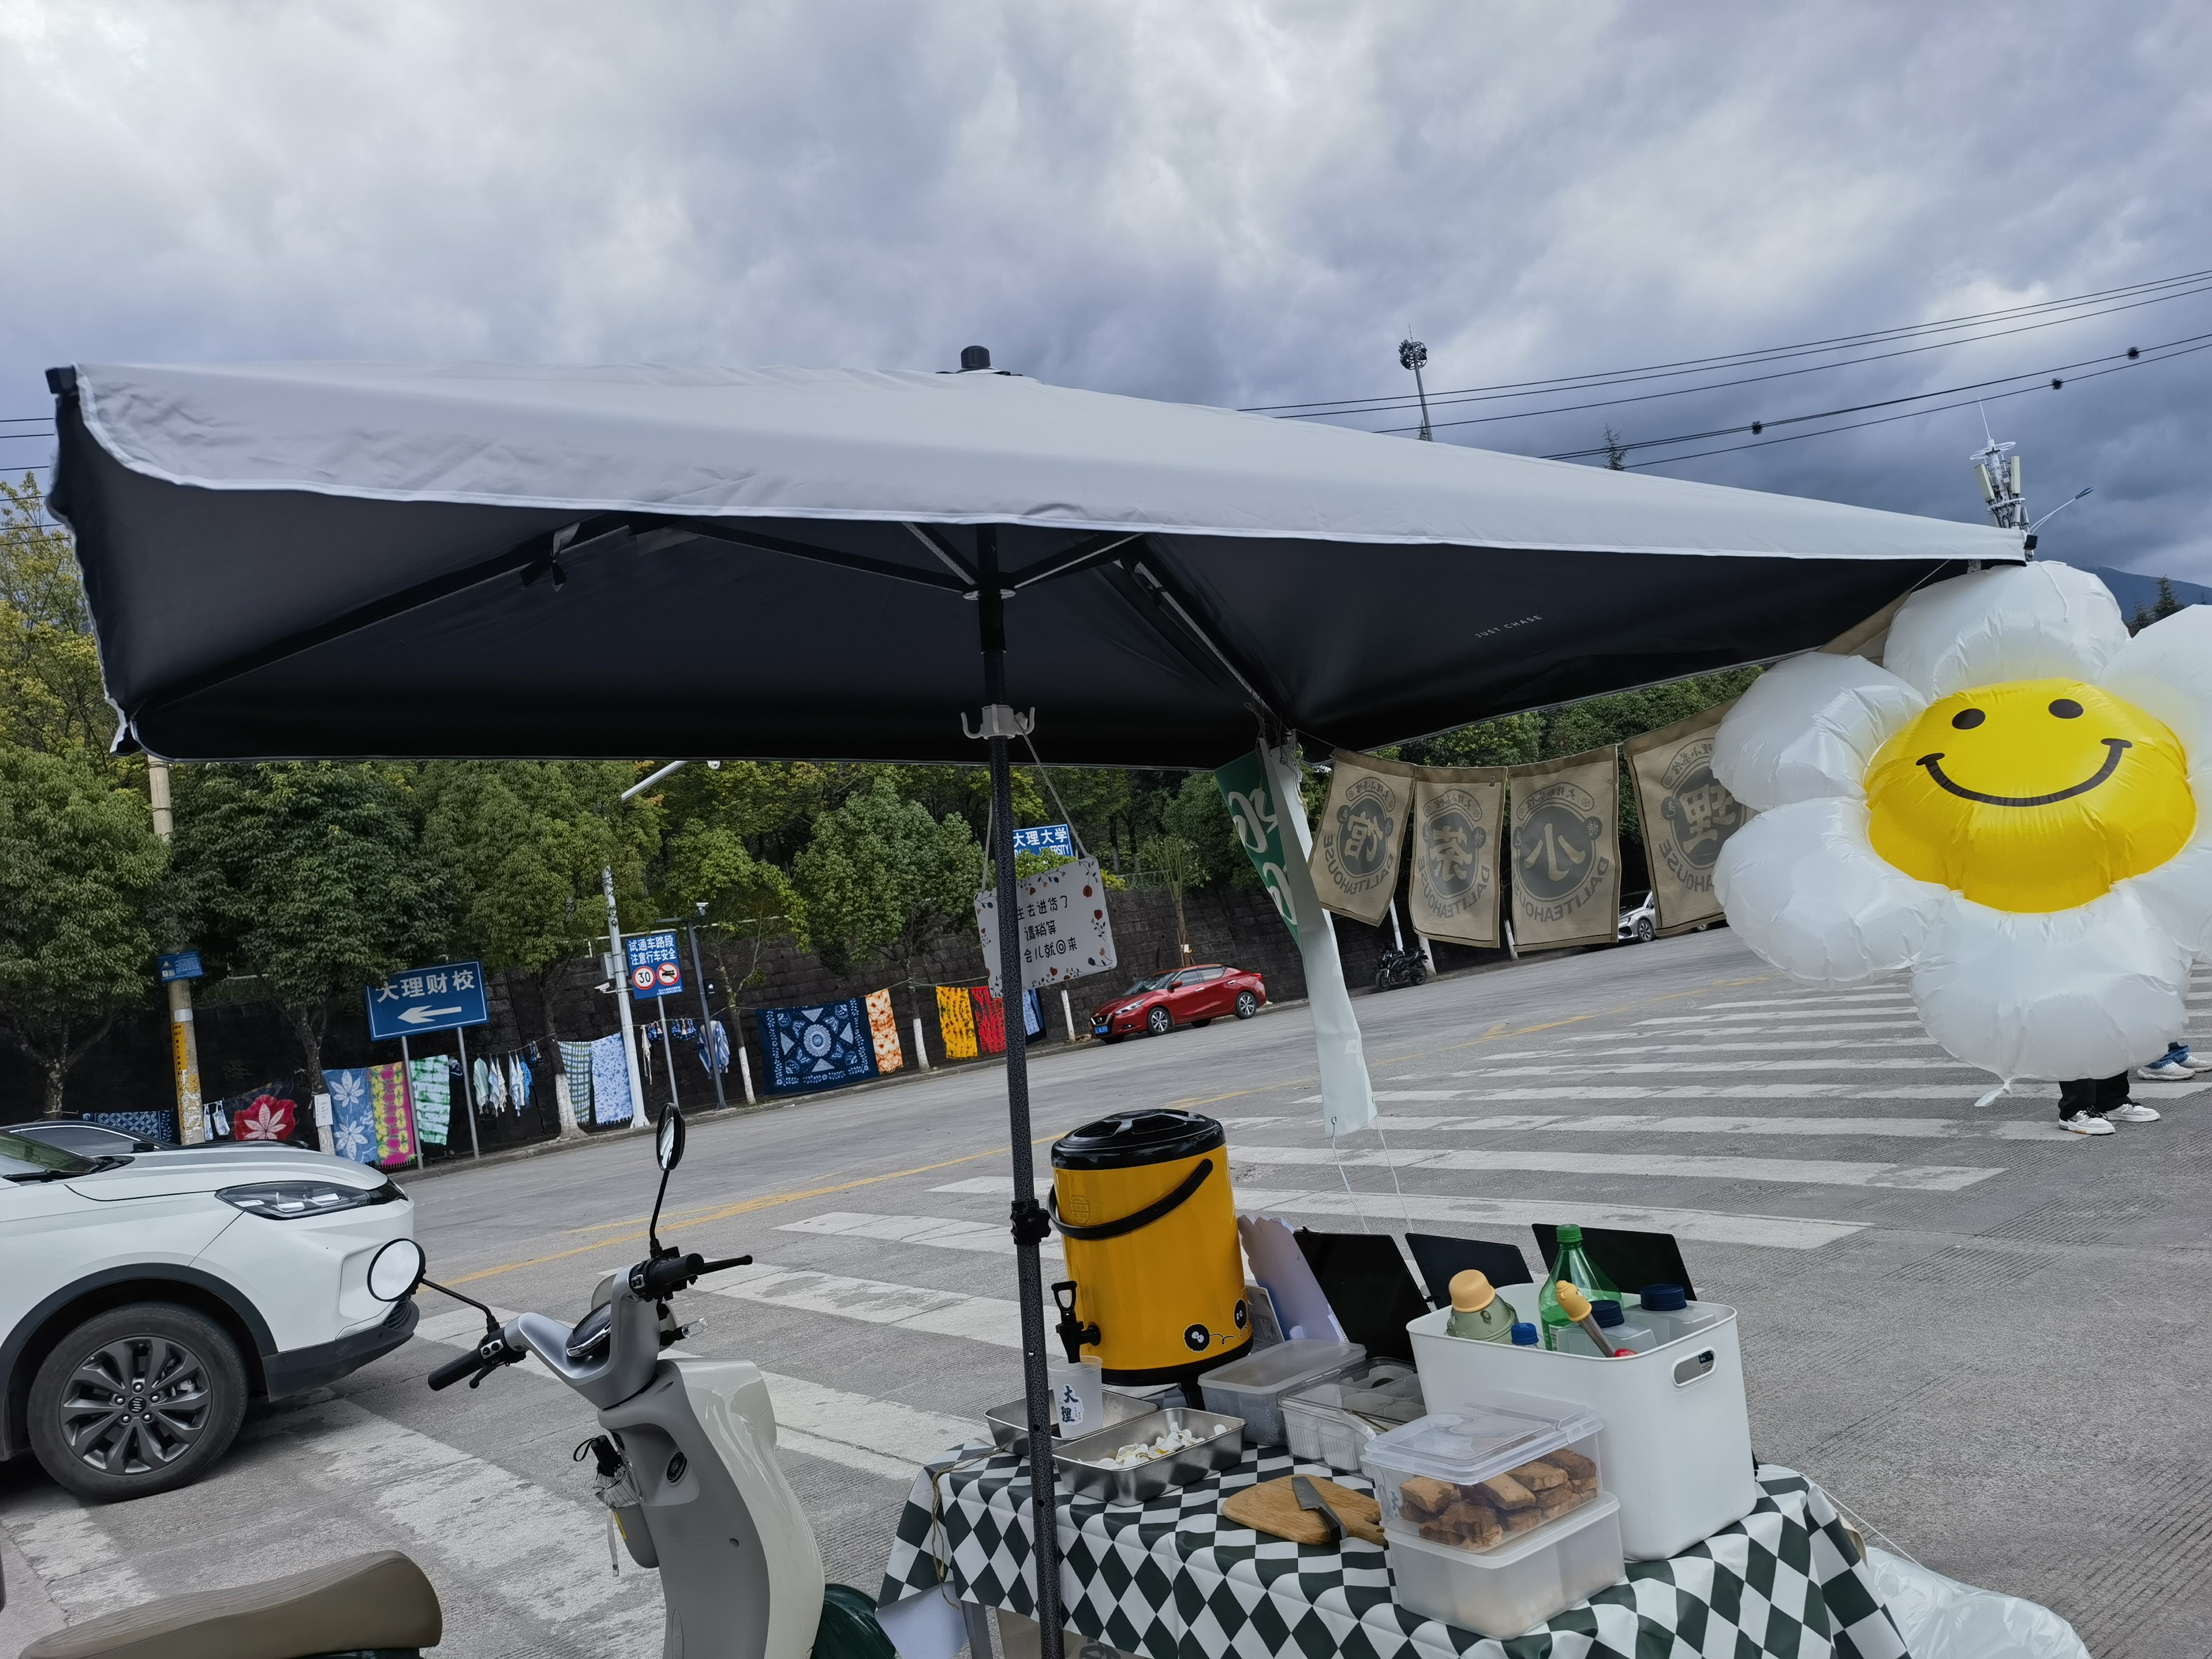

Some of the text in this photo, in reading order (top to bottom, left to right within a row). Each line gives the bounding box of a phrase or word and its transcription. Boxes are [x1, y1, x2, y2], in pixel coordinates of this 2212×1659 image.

[1474, 615, 1543, 638] JUST CHASE
[1013, 827, 1068, 848] 大理大学
[1017, 895, 1068, 920] 主去进货了
[1024, 920, 1056, 941] 请稍等
[629, 935, 675, 952] 试通车路段
[1024, 937, 1077, 963] 会儿就回来
[630, 948, 677, 966] 注意行车安全
[375, 969, 475, 1003] 大理财校
[638, 972, 651, 983] 30
[1061, 1385, 1079, 1423] 大理
